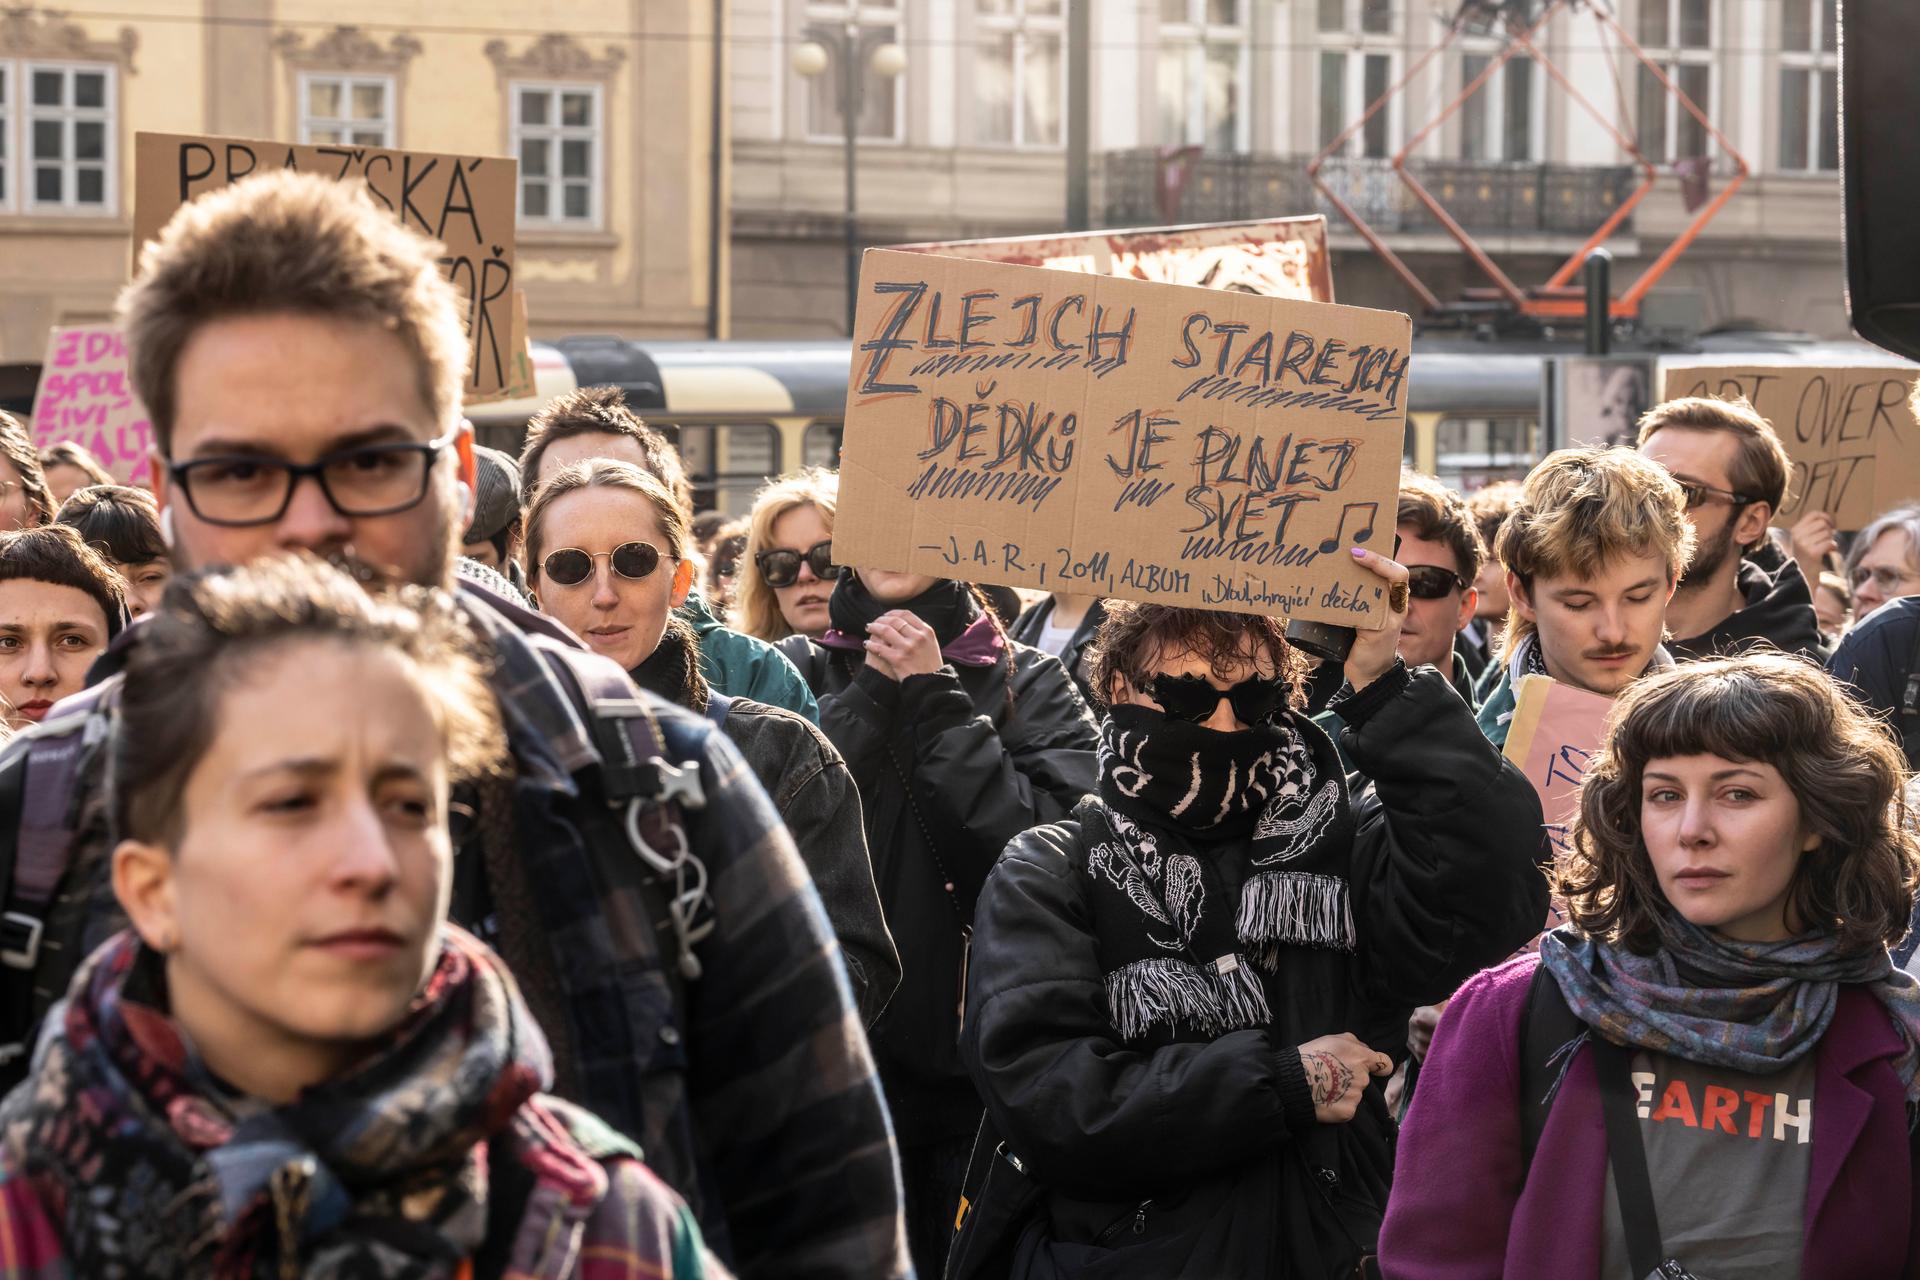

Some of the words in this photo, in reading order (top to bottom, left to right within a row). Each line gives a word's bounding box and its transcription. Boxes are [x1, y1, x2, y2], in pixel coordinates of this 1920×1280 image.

[855, 281, 1135, 406] ZLEJCH
[1794, 375, 1907, 447] OVER
[1104, 407, 1181, 480] JE
[1188, 424, 1365, 491] PLNEJ
[1120, 558, 1190, 593] ALBUM
[1631, 1071, 1811, 1145] EARTH
